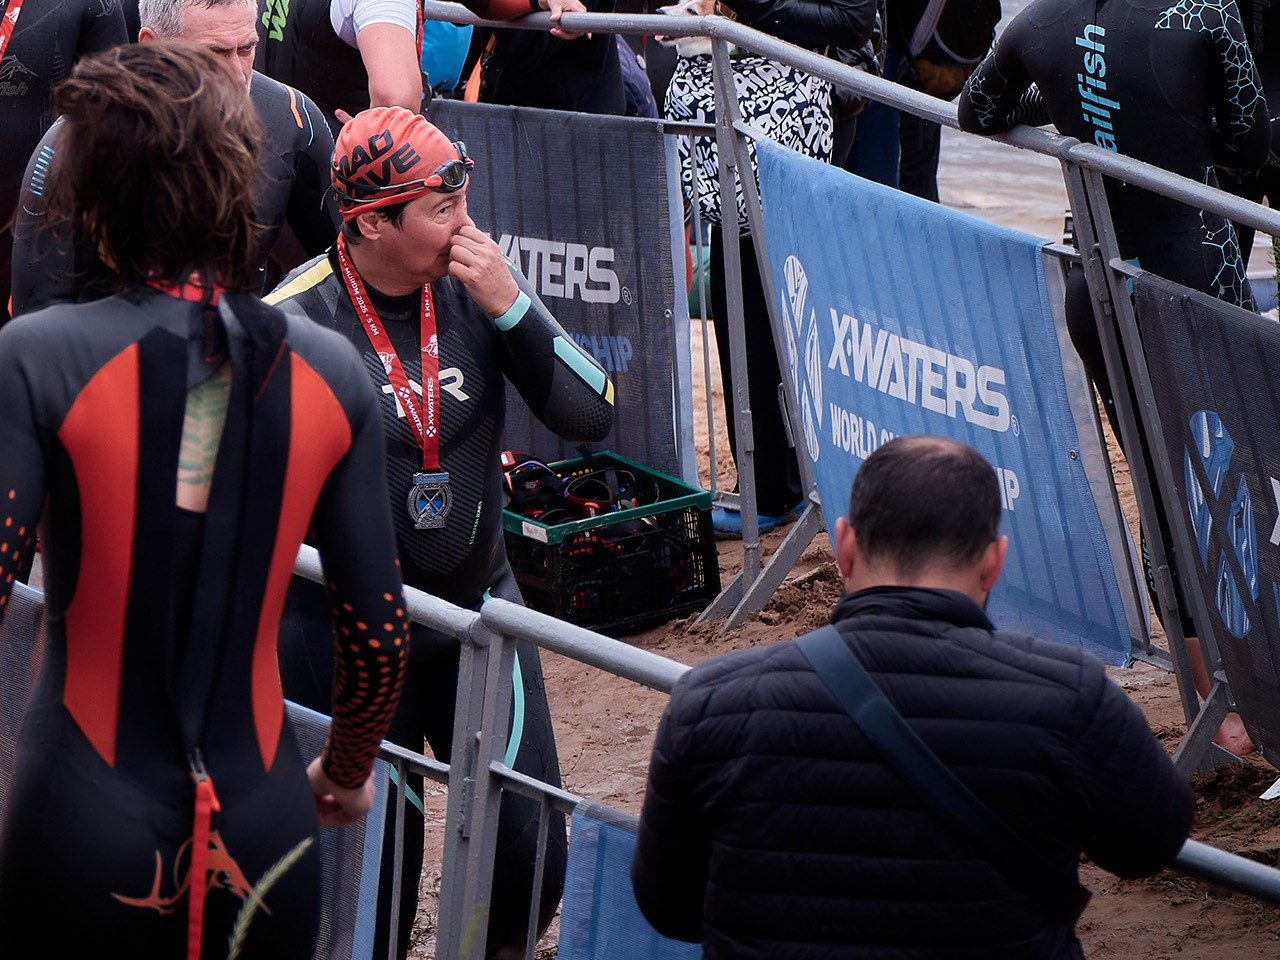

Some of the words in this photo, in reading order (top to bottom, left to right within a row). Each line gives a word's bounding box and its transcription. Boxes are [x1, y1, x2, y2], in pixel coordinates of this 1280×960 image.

[1075, 23, 1121, 153] ailfish
[340, 129, 394, 178] MAD
[344, 267, 360, 295] MUROM
[355, 296, 368, 315] 2025
[424, 298, 431, 313] KM
[366, 317, 373, 326] 5
[369, 323, 380, 337] KM
[829, 402, 878, 461] WORLD
